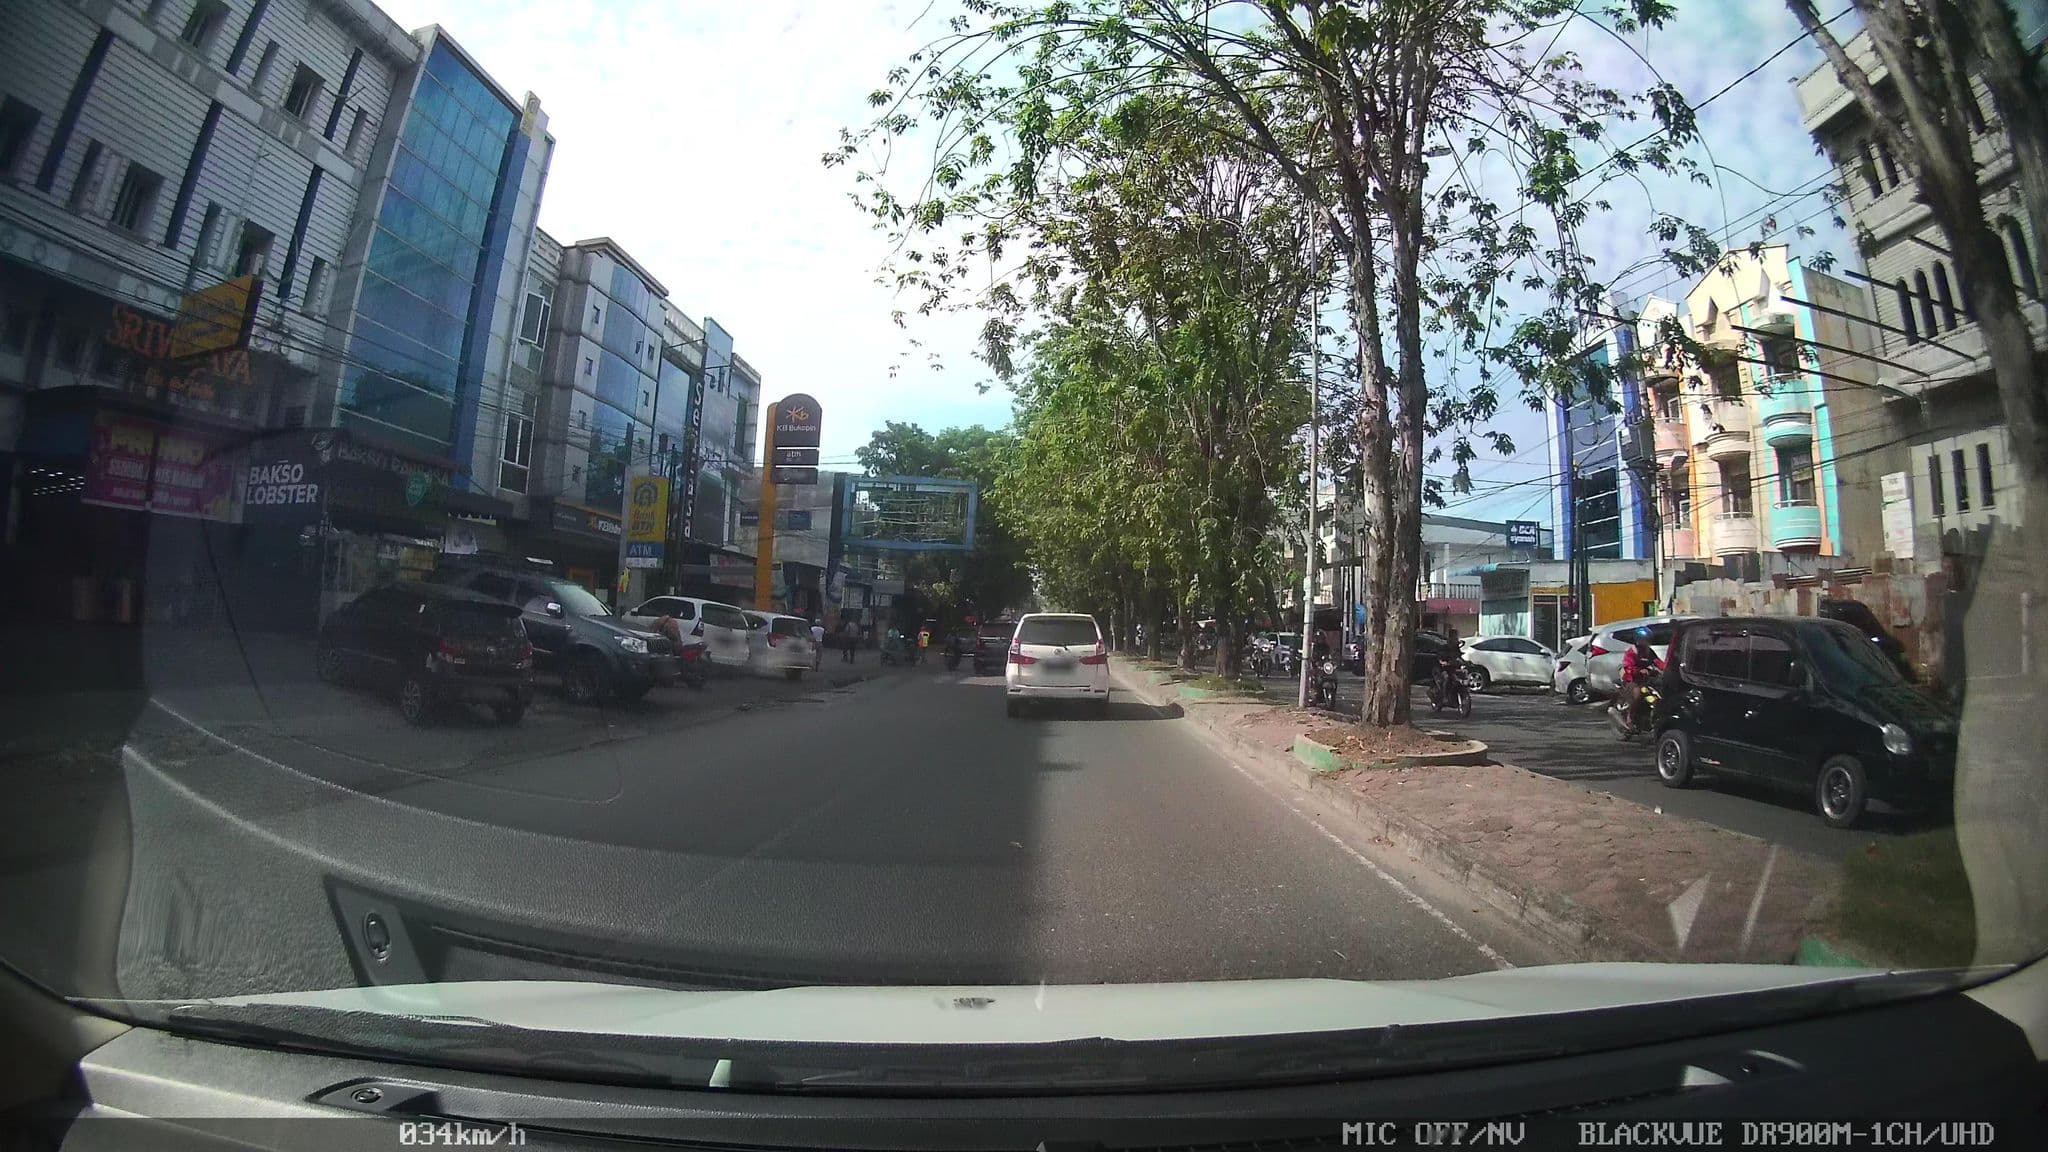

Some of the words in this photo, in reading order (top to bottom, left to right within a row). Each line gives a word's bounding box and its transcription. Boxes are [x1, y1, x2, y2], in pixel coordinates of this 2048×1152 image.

[248, 463, 305, 485] BAKSO
[247, 484, 318, 505] LOBSTER
[629, 544, 652, 556] ATM
